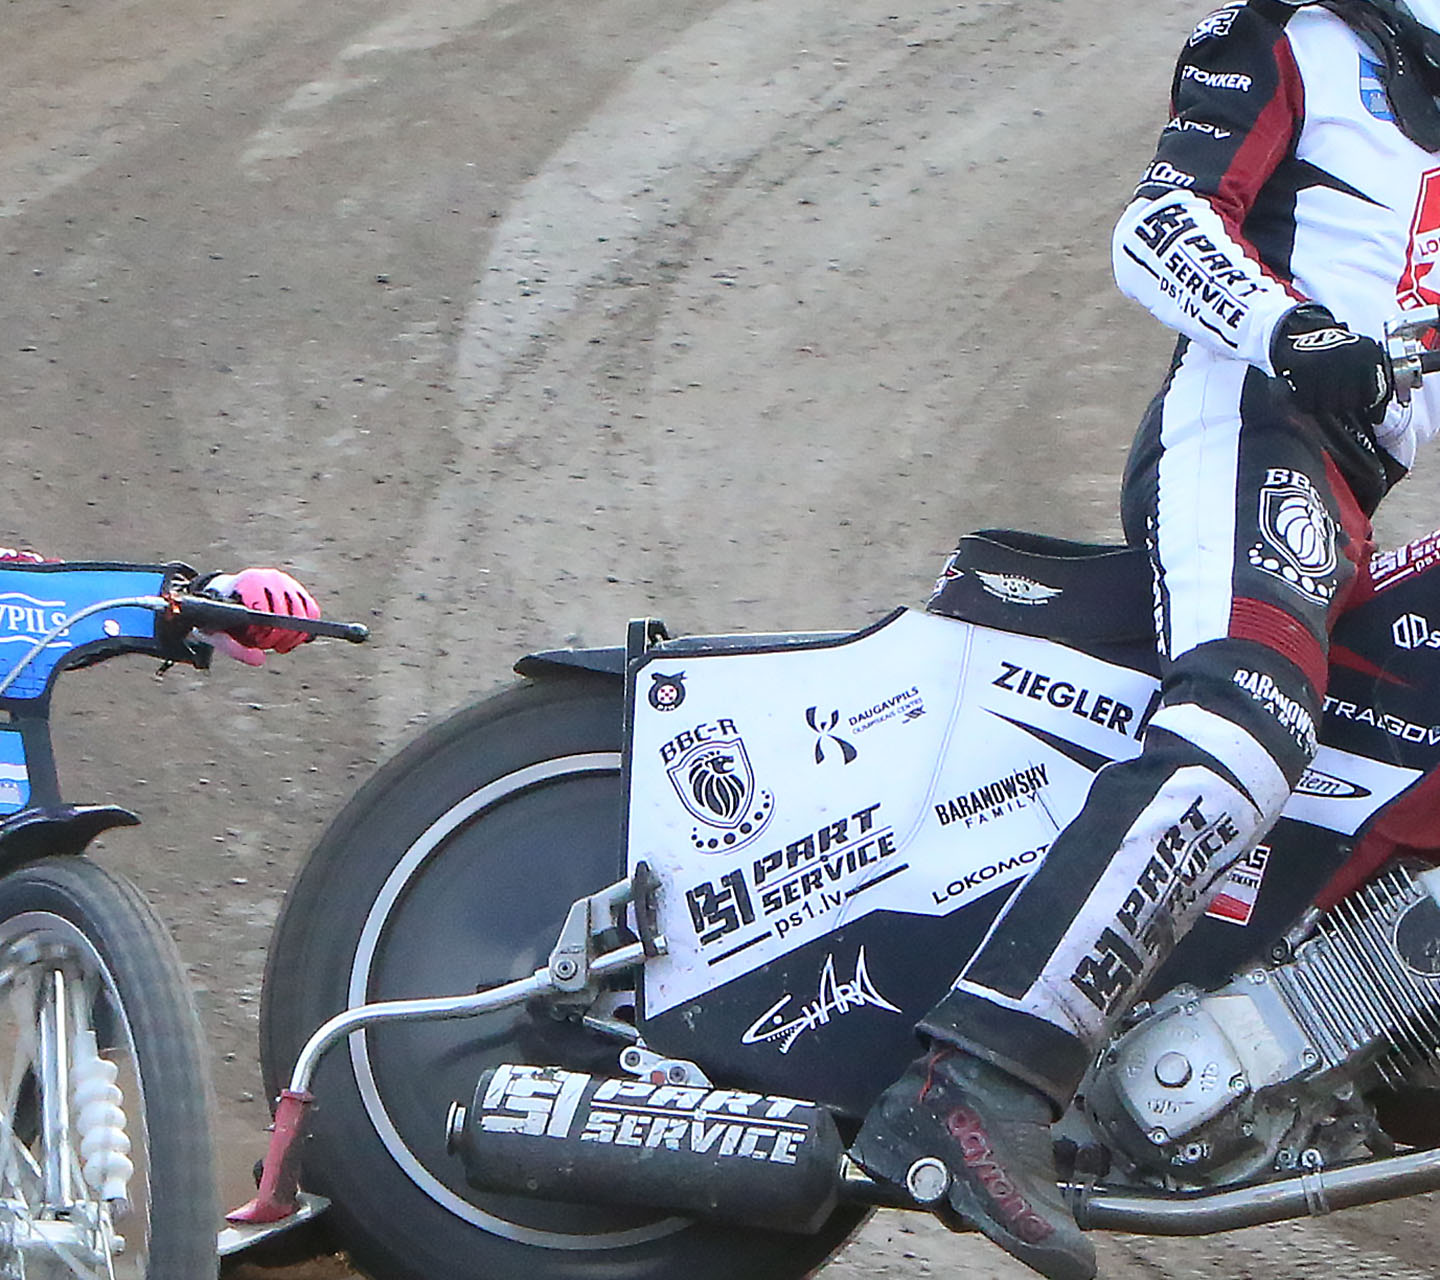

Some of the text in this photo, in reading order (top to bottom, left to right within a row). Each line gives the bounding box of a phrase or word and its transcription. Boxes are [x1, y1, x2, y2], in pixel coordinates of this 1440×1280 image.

[1164, 251, 1245, 330] SERVICE
[1183, 234, 1269, 298] PART
[848, 685, 919, 727] DAUGAVPILS
[991, 661, 1134, 734] ZIEGLER
[658, 718, 739, 767] BBC-R
[934, 762, 1050, 826] BARANOWSKY
[964, 791, 1040, 830] FAMILY
[753, 802, 883, 887] PART
[762, 832, 898, 916] SERVICE
[1116, 795, 1208, 937] PART
[774, 889, 847, 939] ps1.lv
[592, 1078, 816, 1120] PART
[580, 1110, 806, 1166] SERVICE
